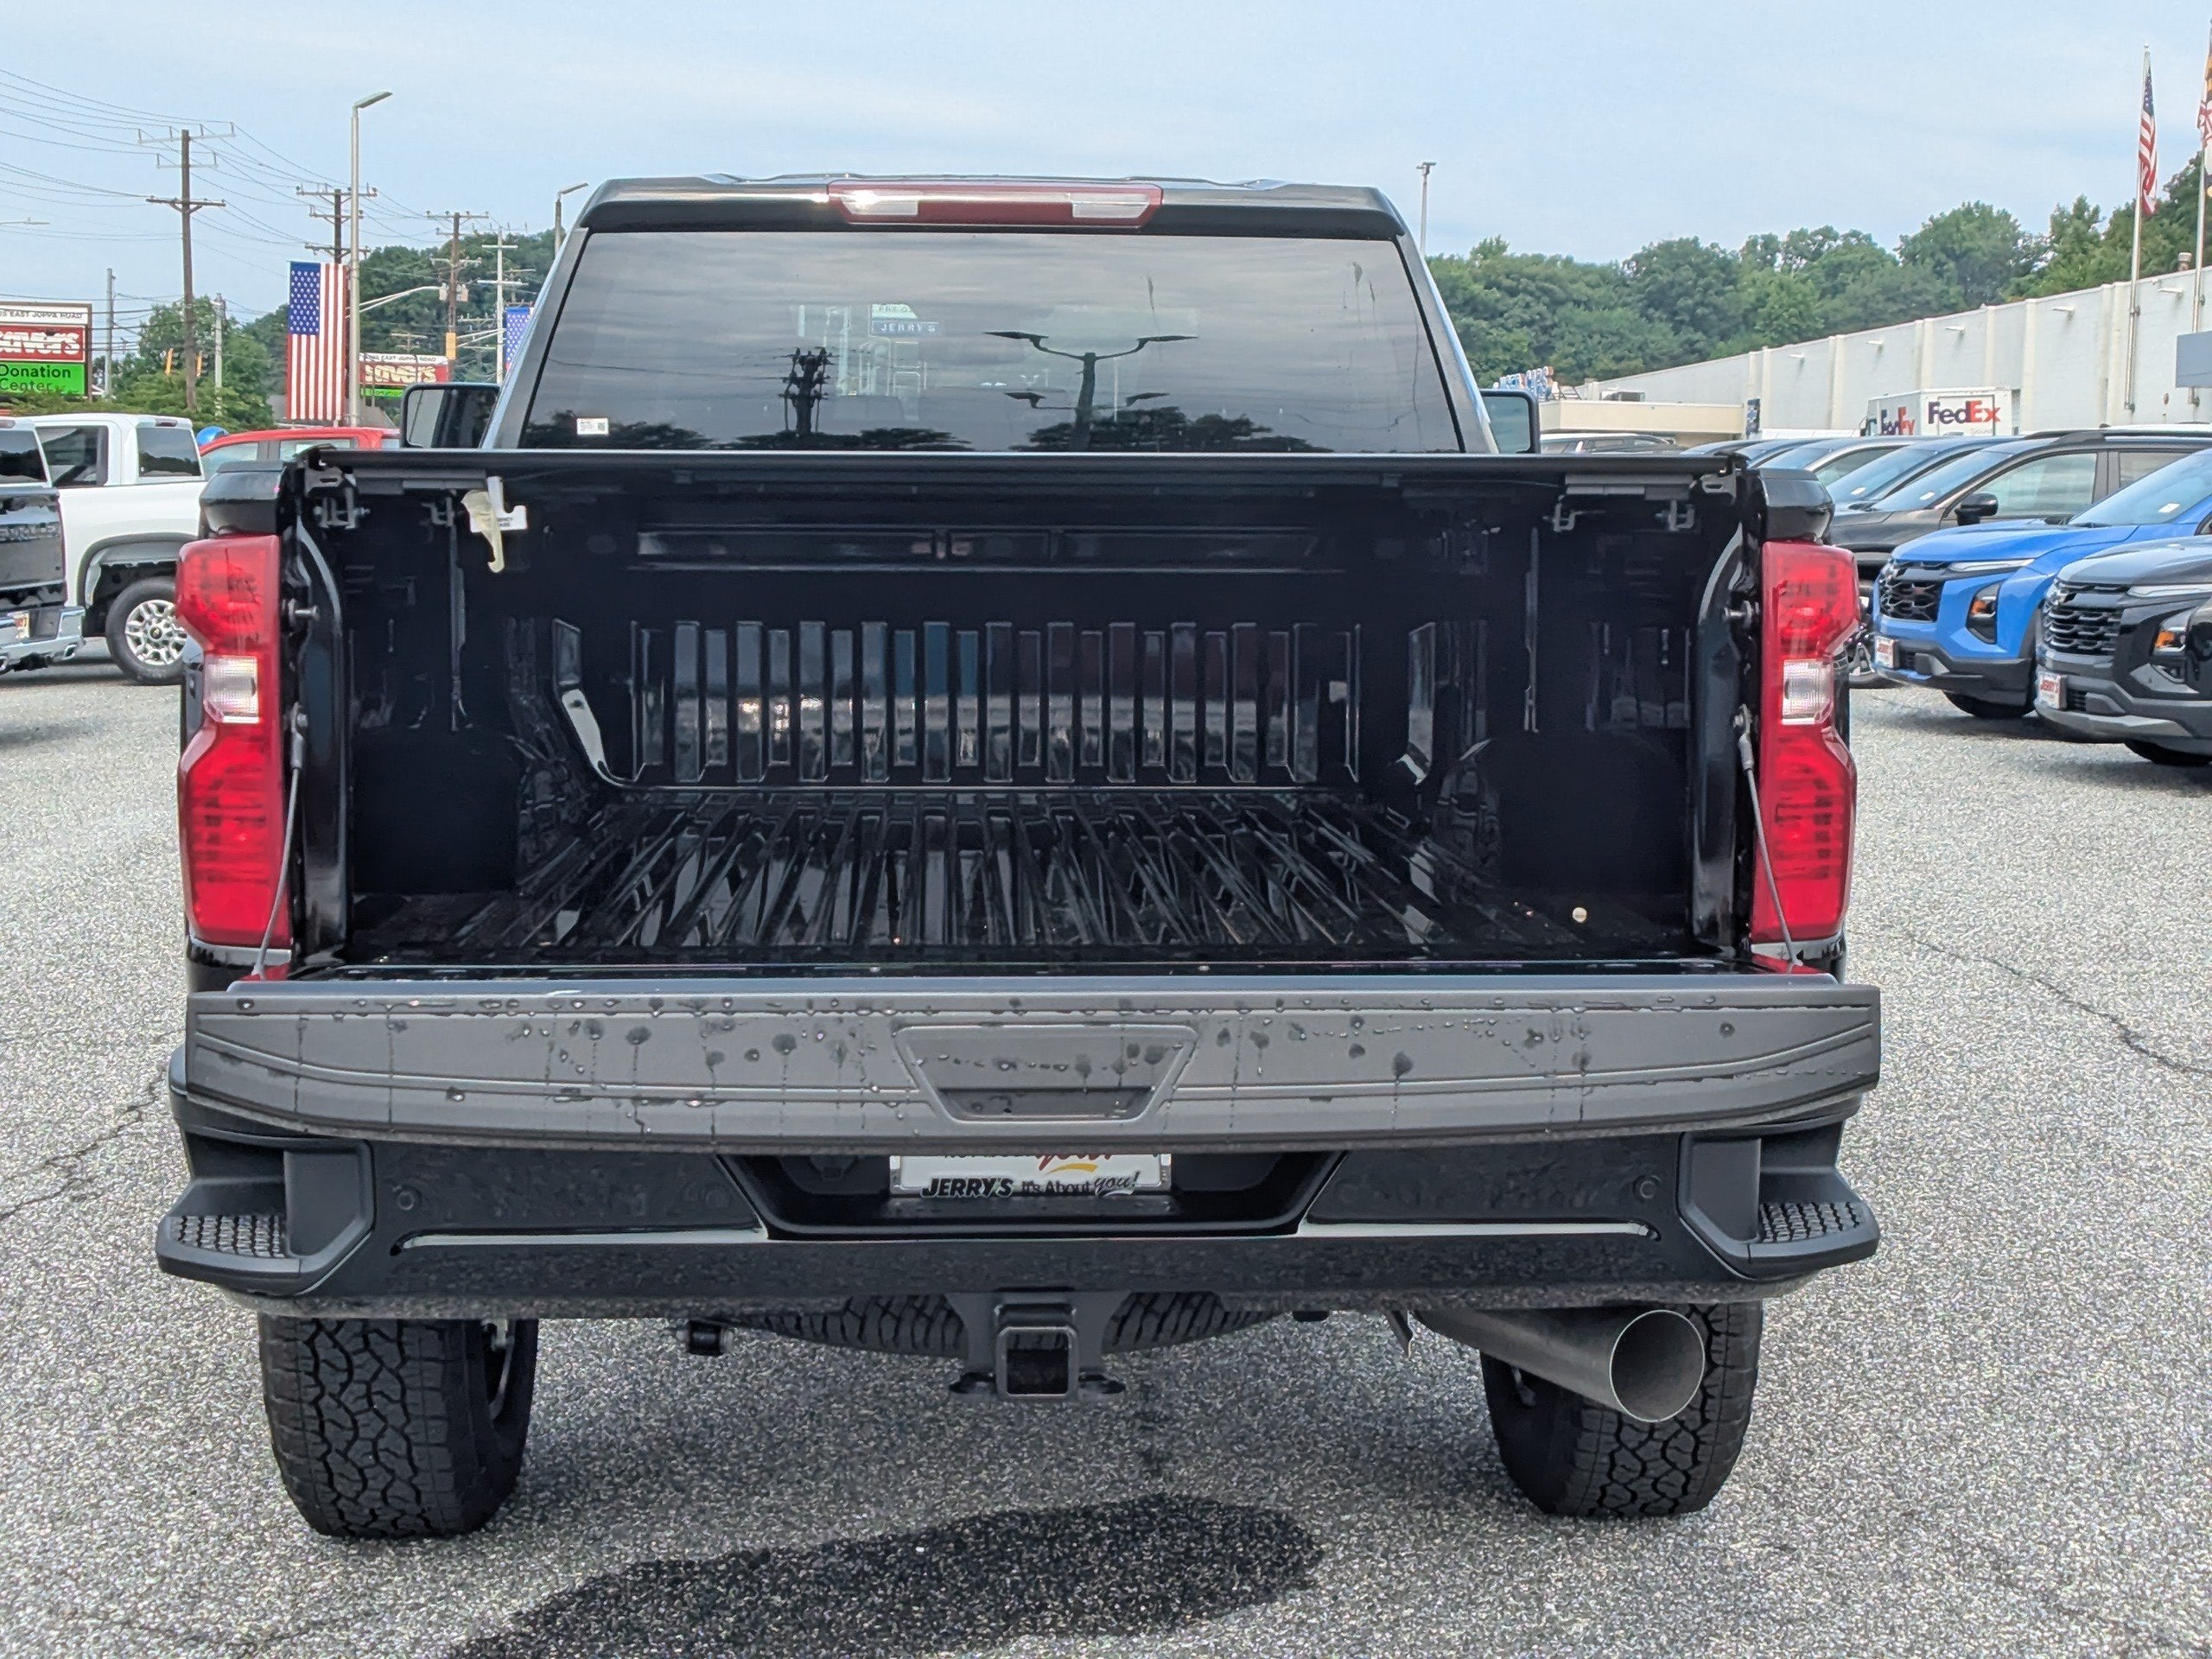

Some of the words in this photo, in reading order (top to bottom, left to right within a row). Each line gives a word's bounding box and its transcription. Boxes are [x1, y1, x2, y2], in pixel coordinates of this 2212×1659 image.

[0, 331, 80, 355] avers
[0, 364, 72, 378] Donation
[0, 378, 53, 391] Center
[1928, 400, 2001, 424] FedEx
[921, 1176, 1014, 1197] JERRY'S
[1042, 1179, 1091, 1193] About
[1093, 1169, 1141, 1194] you!
